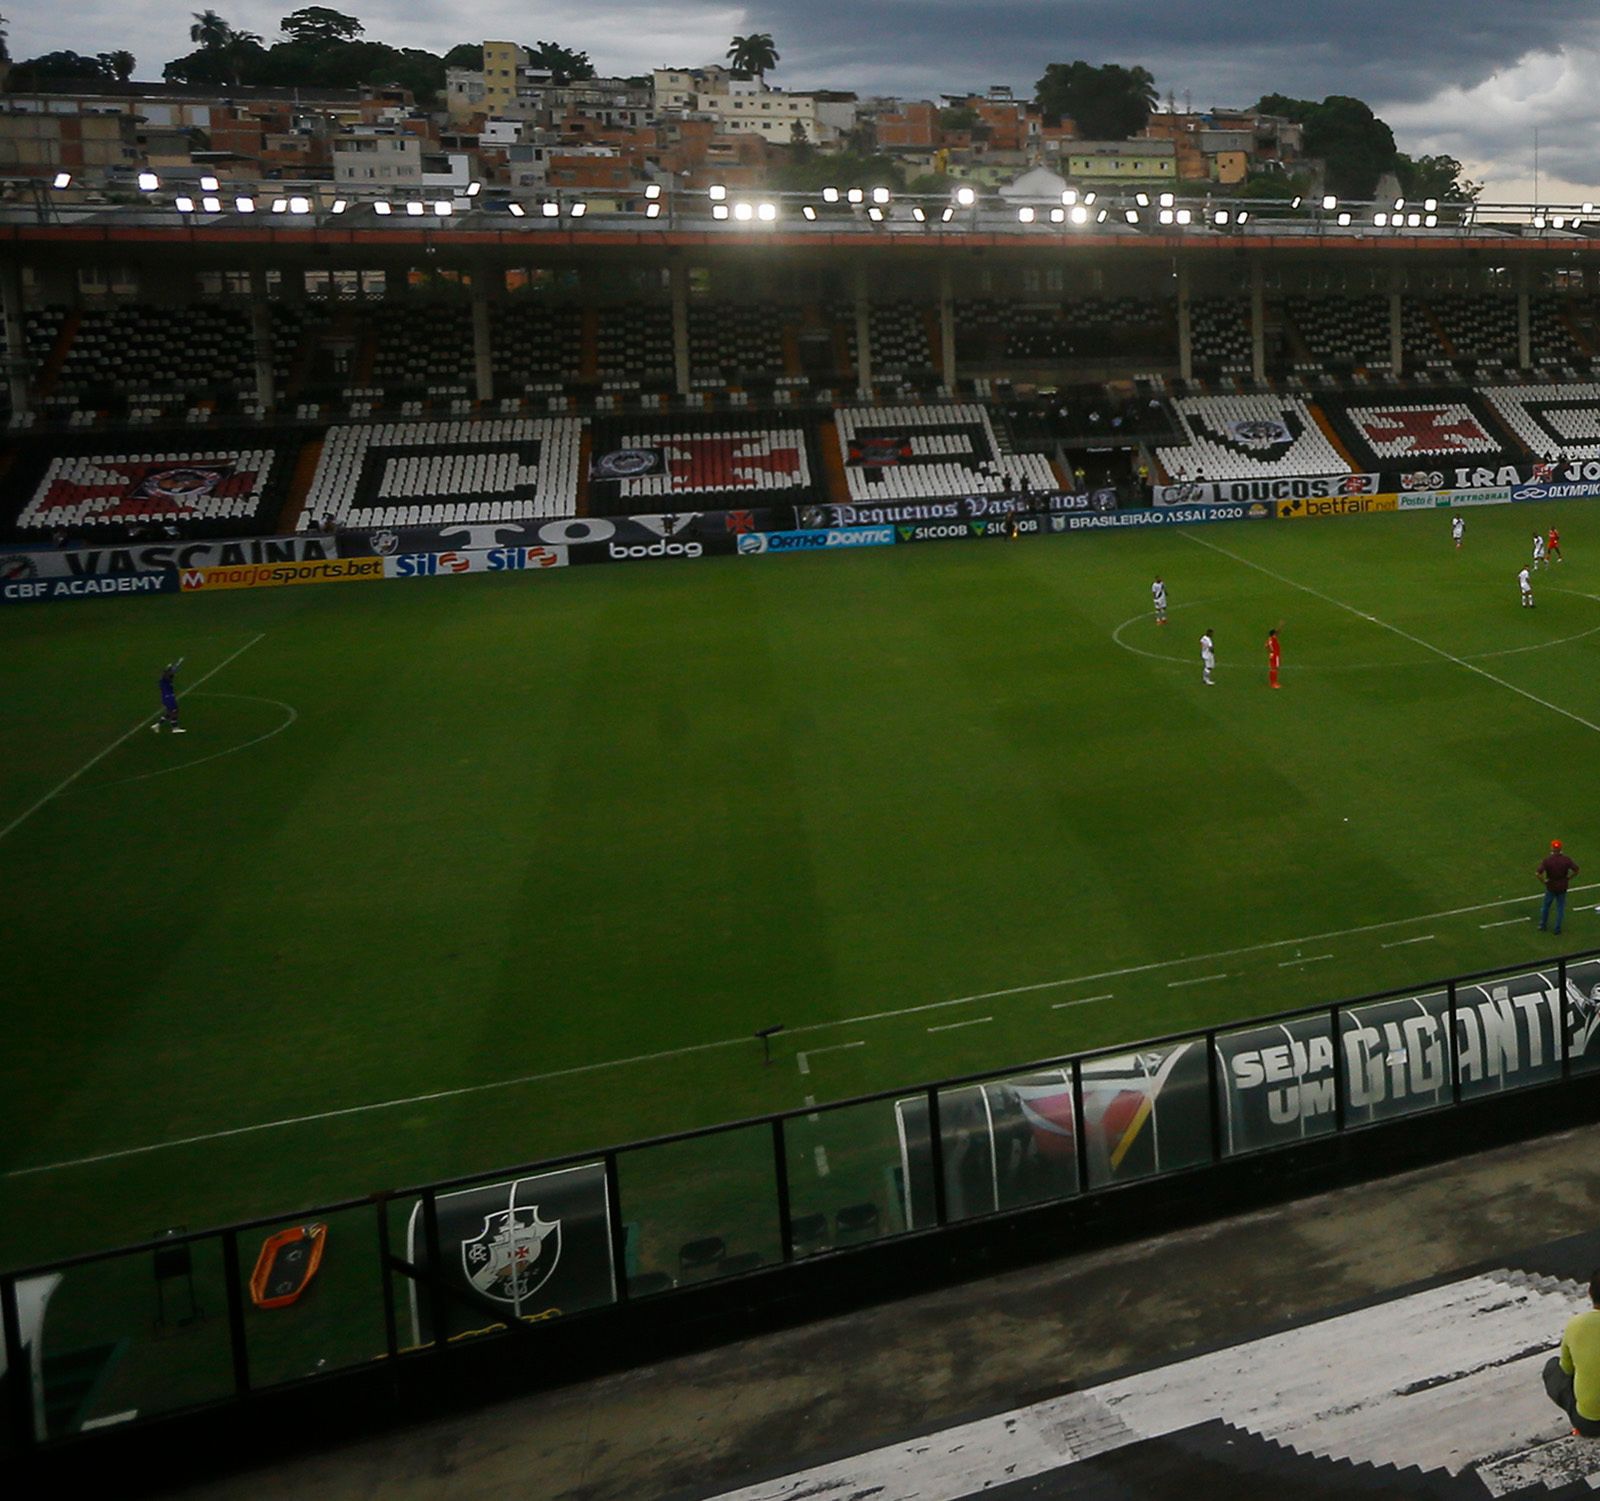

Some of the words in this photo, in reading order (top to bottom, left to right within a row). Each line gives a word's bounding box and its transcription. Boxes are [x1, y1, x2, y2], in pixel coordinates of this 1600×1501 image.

[1455, 465, 1522, 489] IRA
[1212, 478, 1329, 503] LOUCOS
[1453, 491, 1510, 504] PETROBRAS
[829, 499, 959, 529] Pequenos
[1069, 511, 1162, 530] BRASILEIRÃO
[1209, 506, 1243, 521] 2020
[915, 524, 968, 540] SICOOB
[486, 547, 526, 571] Sil
[609, 539, 704, 560] bodog
[207, 560, 383, 587] marjosports.bet
[396, 553, 437, 577] Sil
[4, 583, 49, 599] CBF
[53, 575, 166, 597] ACADEMY
[1343, 986, 1590, 1109] GIGANTE
[1231, 1035, 1335, 1090] SEJA
[1267, 1077, 1336, 1125] UM
